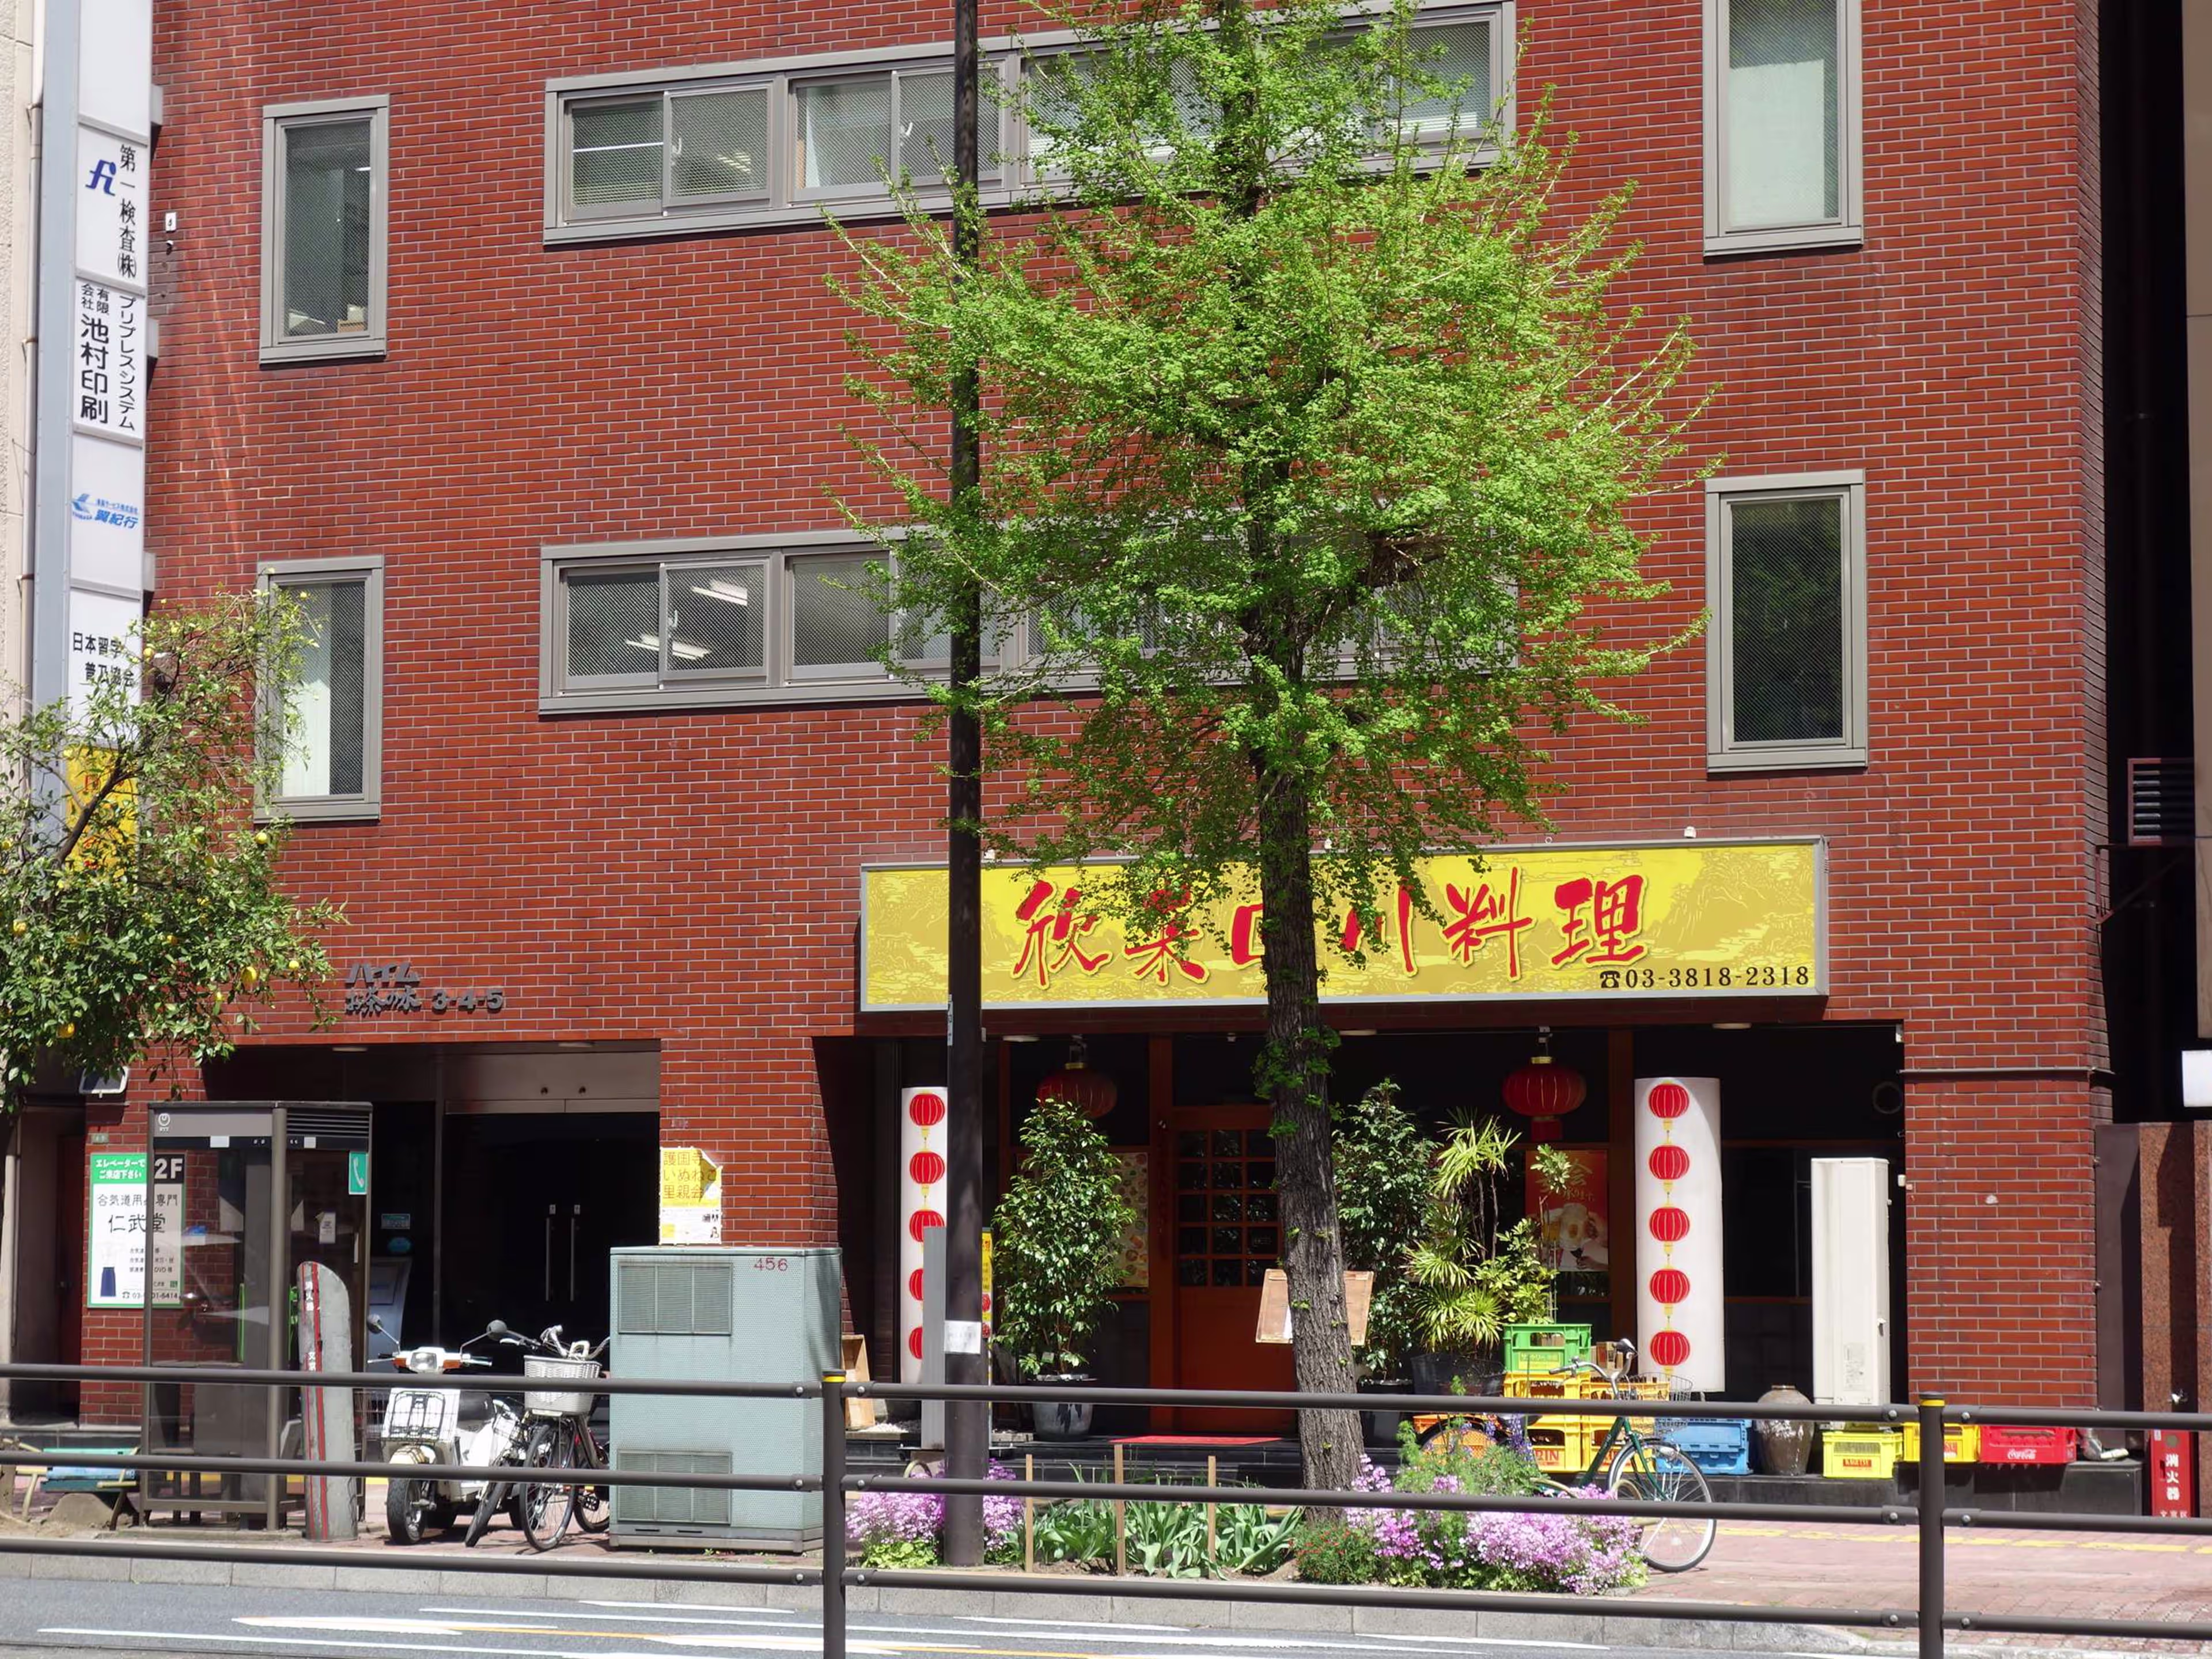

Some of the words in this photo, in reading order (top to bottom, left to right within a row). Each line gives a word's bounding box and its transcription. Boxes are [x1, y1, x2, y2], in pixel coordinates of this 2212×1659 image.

[81, 313, 109, 424] 池村印刷
[119, 295, 137, 431] プリプレスシステム
[1626, 967, 1809, 988] 03-3818-2318
[154, 1158, 183, 1180] 2F
[97, 1194, 179, 1207] 合気道用専門
[753, 1257, 788, 1272] 456
[2165, 1453, 2180, 1501] 消火器
